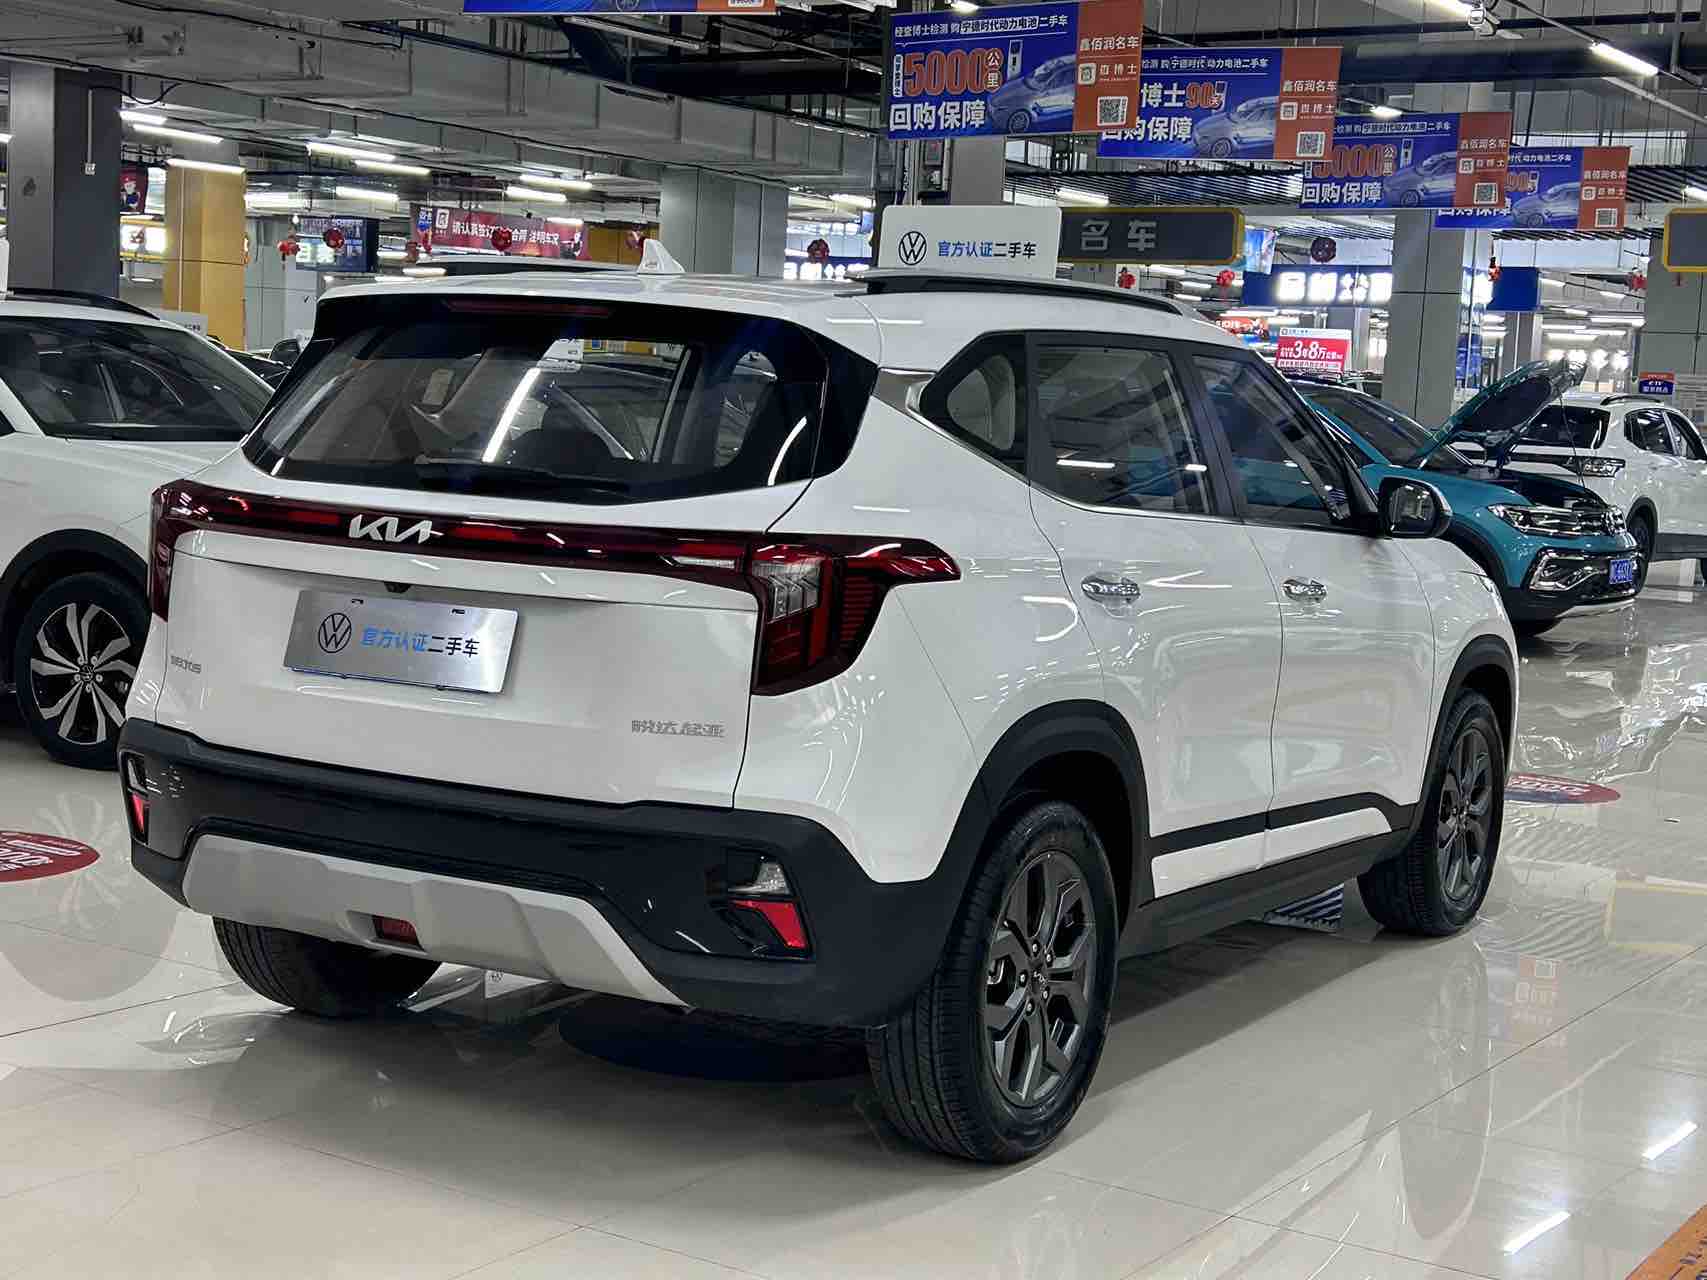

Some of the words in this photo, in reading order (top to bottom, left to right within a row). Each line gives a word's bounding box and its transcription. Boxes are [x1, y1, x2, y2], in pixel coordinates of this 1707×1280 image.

[904, 50, 988, 97] 5000
[986, 51, 1000, 88] 公里
[890, 100, 986, 131] 回购保障
[1302, 182, 1382, 204] 回购保障
[938, 240, 1037, 259] 官方认证二手车
[349, 514, 432, 544] KIA
[360, 625, 480, 659] 官方认证二手车
